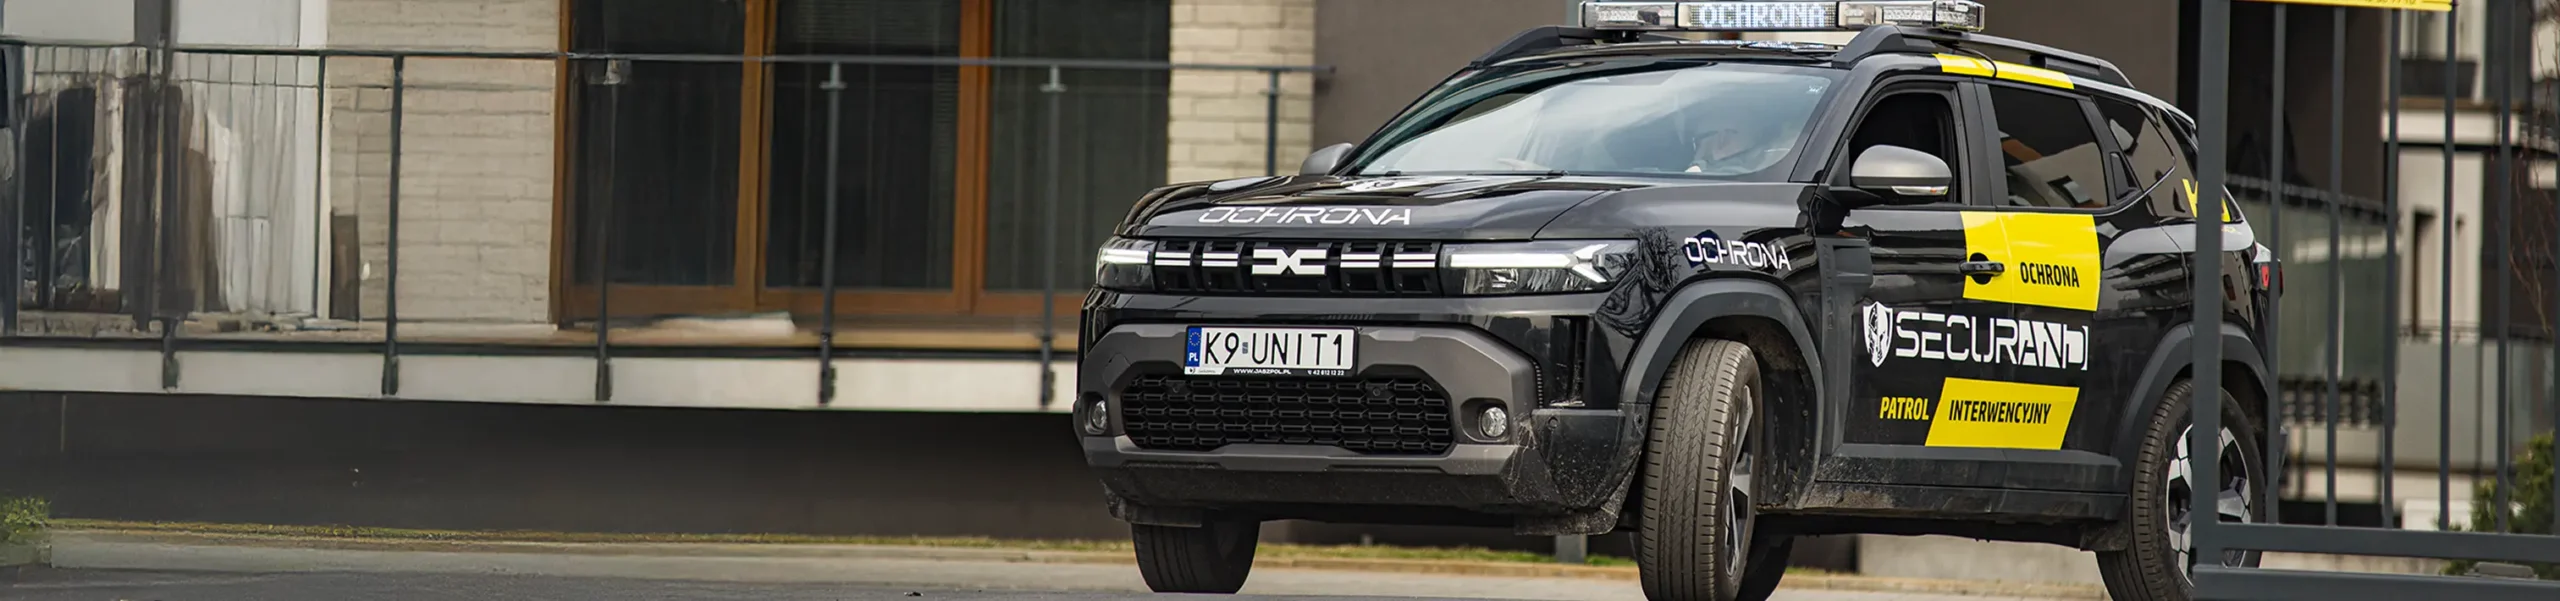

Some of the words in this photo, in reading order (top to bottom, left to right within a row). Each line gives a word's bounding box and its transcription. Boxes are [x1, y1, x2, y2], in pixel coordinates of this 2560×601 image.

[1699, 3, 1826, 28] OCHRONA
[1198, 205, 1411, 226] OCHRONA
[1684, 237, 1792, 271] OCHRONA
[2019, 261, 2080, 288] OCHRONA
[1204, 332, 1239, 364] K9
[1252, 333, 1343, 366] UNIT1
[1895, 310, 2089, 371] SECURAND
[1188, 352, 1199, 362] PL
[1879, 396, 1930, 421] PATROL
[1948, 399, 2052, 425] INTERWENCYJNY
